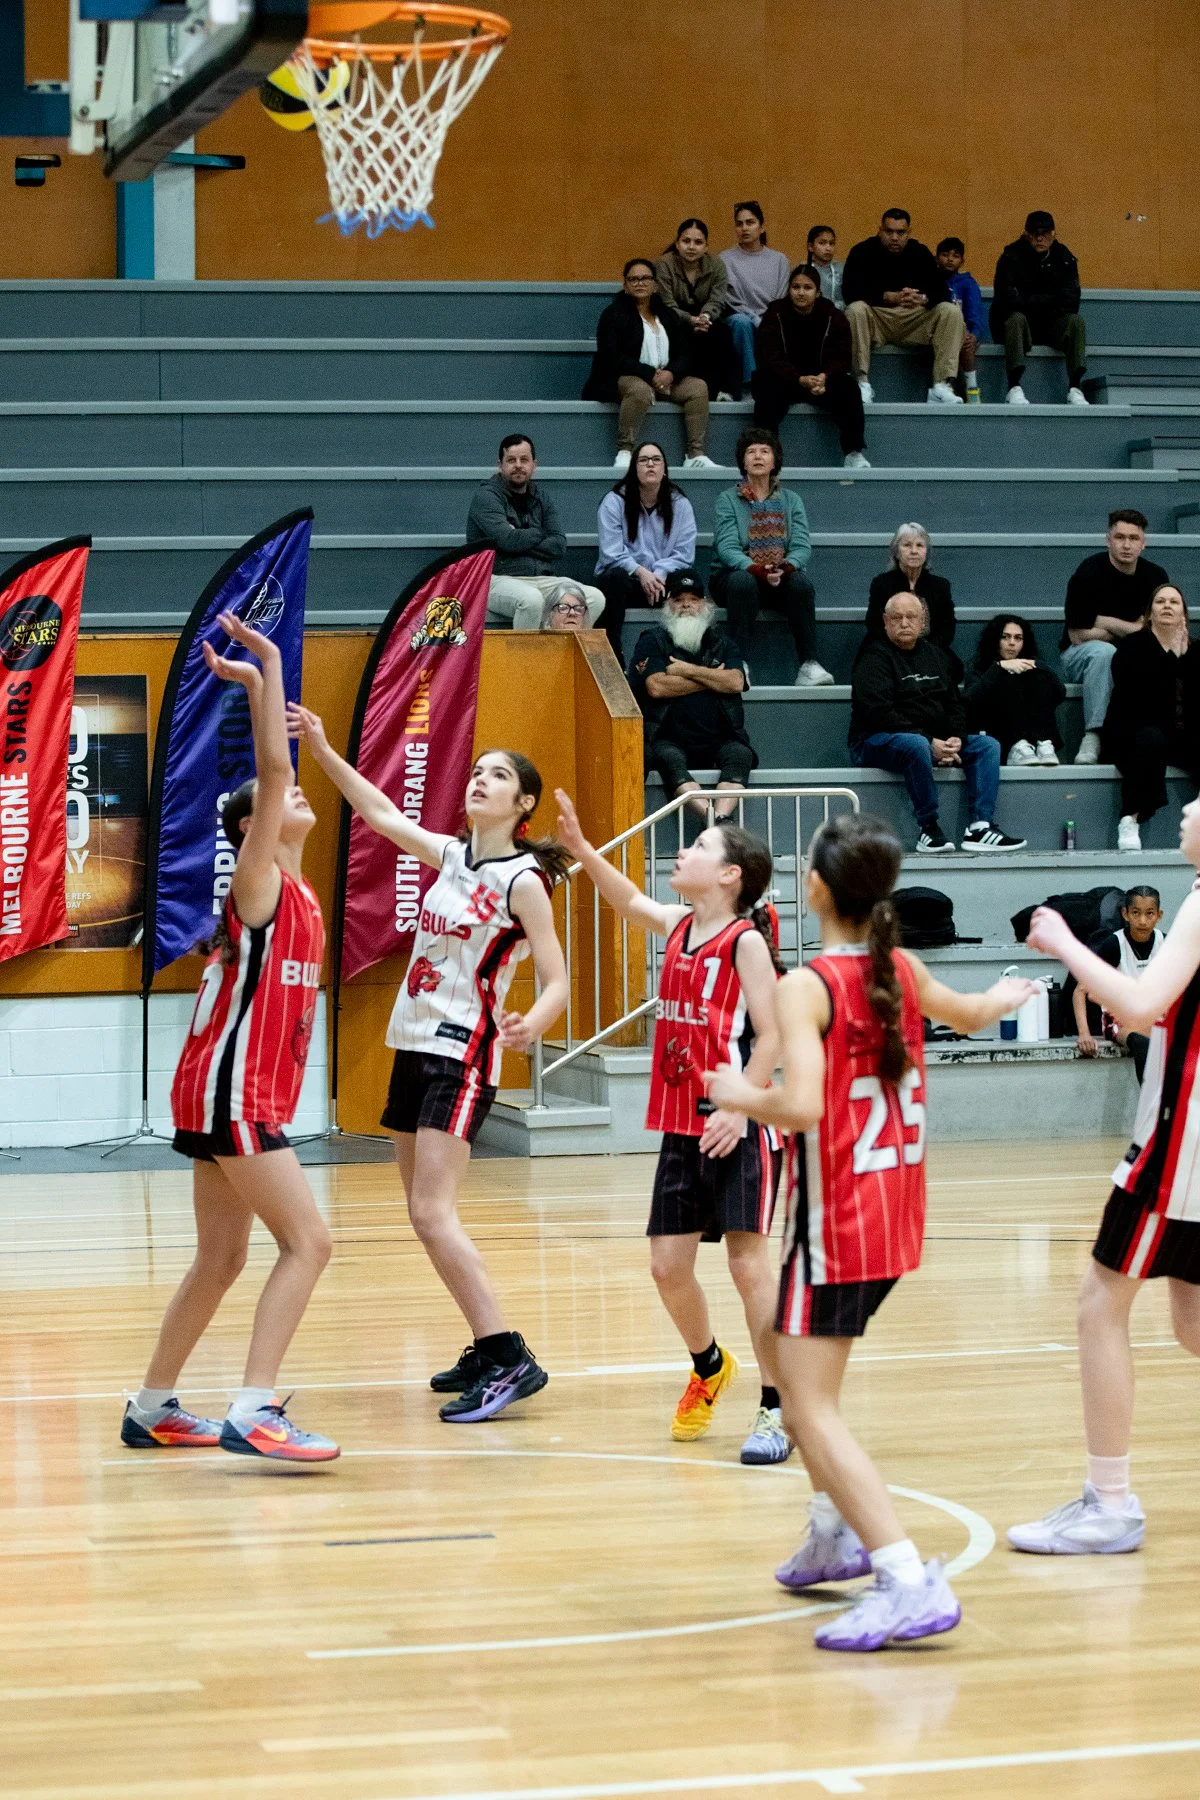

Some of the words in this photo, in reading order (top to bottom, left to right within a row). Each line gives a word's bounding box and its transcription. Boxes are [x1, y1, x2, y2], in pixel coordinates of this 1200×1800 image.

[13, 627, 59, 645] STARS
[4, 681, 32, 764] STARS
[216, 681, 252, 780] STOR
[404, 668, 434, 735] LIONS
[402, 742, 429, 825] ORANG
[0, 772, 29, 936] MELBOURNE
[395, 854, 420, 933] SOUTH
[466, 881, 502, 923] 55
[280, 959, 320, 989] BUL
[701, 956, 722, 1000] 1
[655, 998, 709, 1027] BULLS
[848, 1066, 926, 1175] 25
